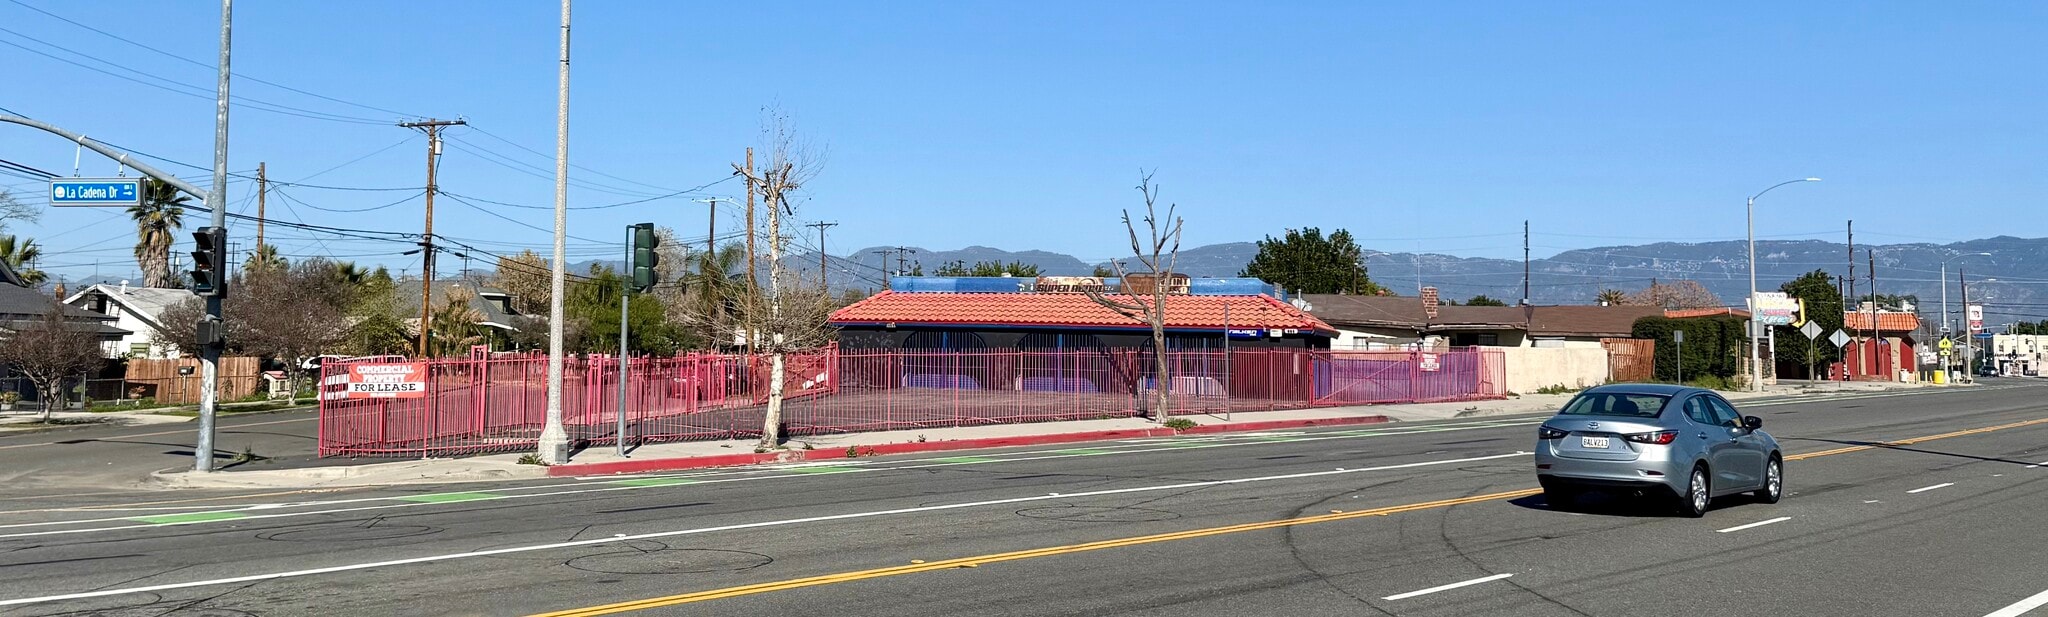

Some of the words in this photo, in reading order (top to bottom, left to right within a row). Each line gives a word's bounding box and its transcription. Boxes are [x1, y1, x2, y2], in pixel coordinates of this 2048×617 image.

[66, 186, 76, 199] La
[78, 186, 107, 199] Cadena
[109, 186, 119, 199] Dr
[1037, 284, 1071, 293] SUPER
[356, 365, 415, 374] COMMERCIAL
[354, 383, 376, 392] FOR
[377, 383, 417, 392] LEASE
